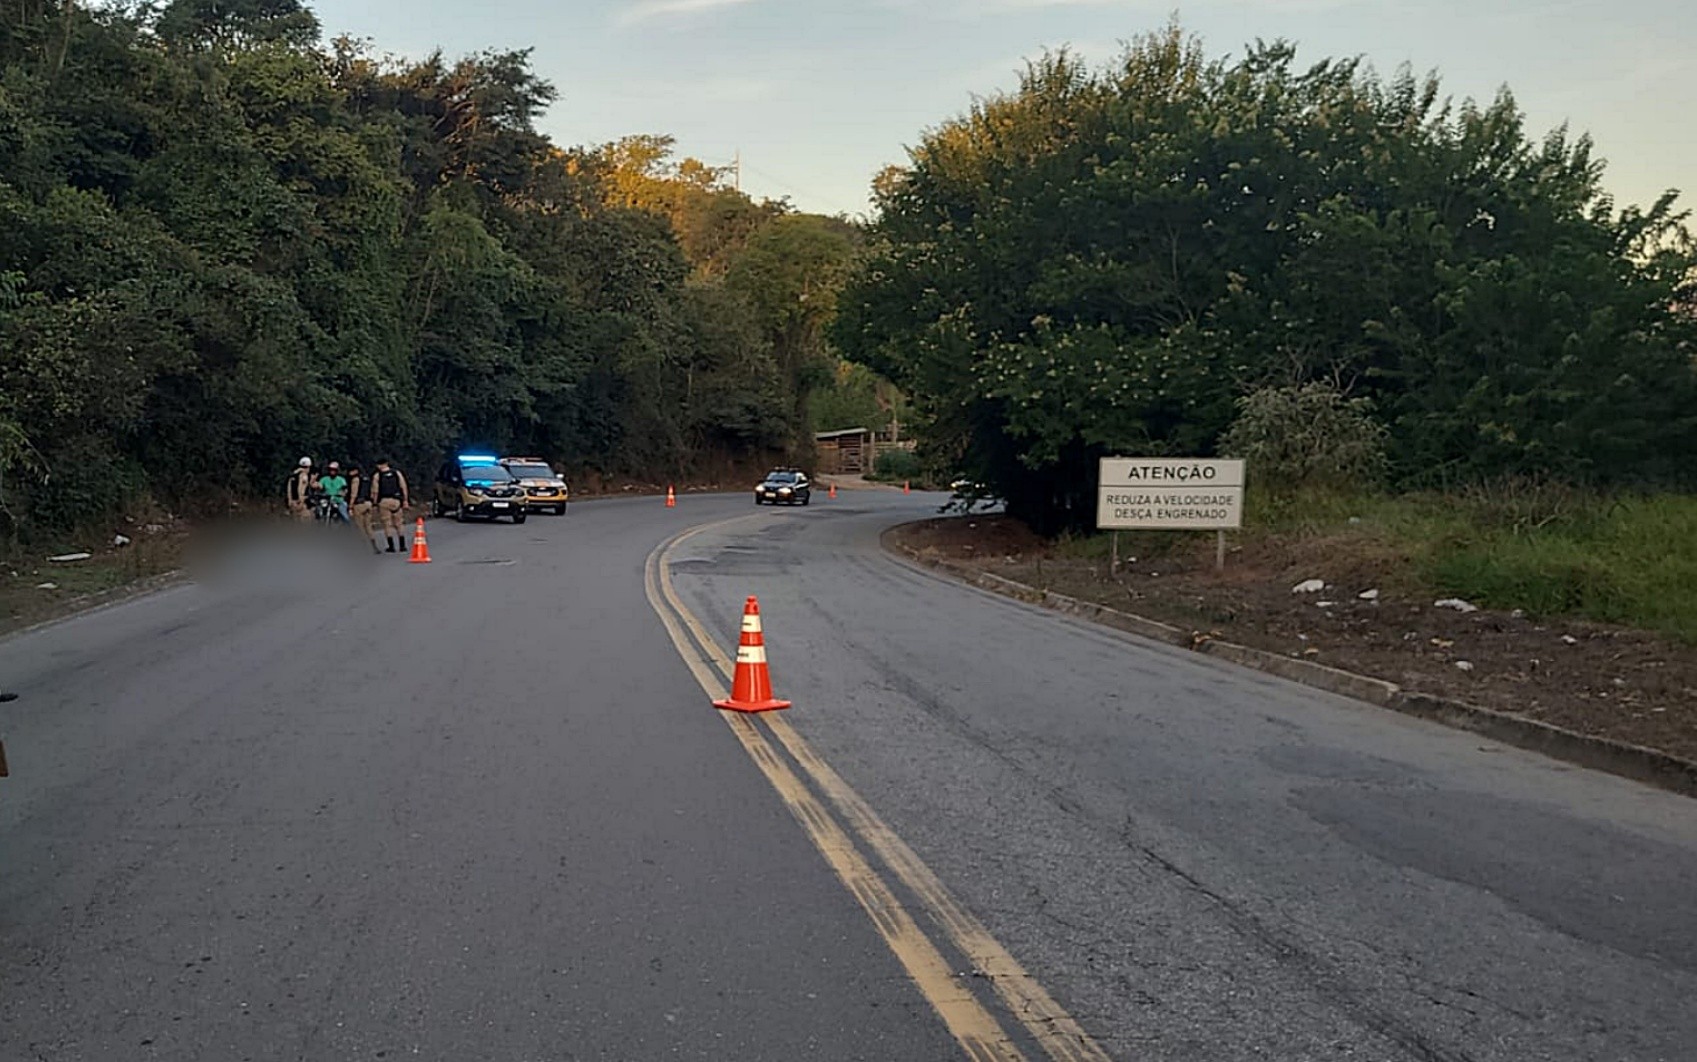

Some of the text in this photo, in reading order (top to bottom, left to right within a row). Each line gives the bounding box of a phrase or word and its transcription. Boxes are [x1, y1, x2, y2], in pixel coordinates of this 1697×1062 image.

[1128, 464, 1216, 481] ATENÇÃO
[1106, 495, 1234, 506] REDUZA A VELOCIDADE
[1114, 508, 1228, 520] DESÇA ENGRENADO
